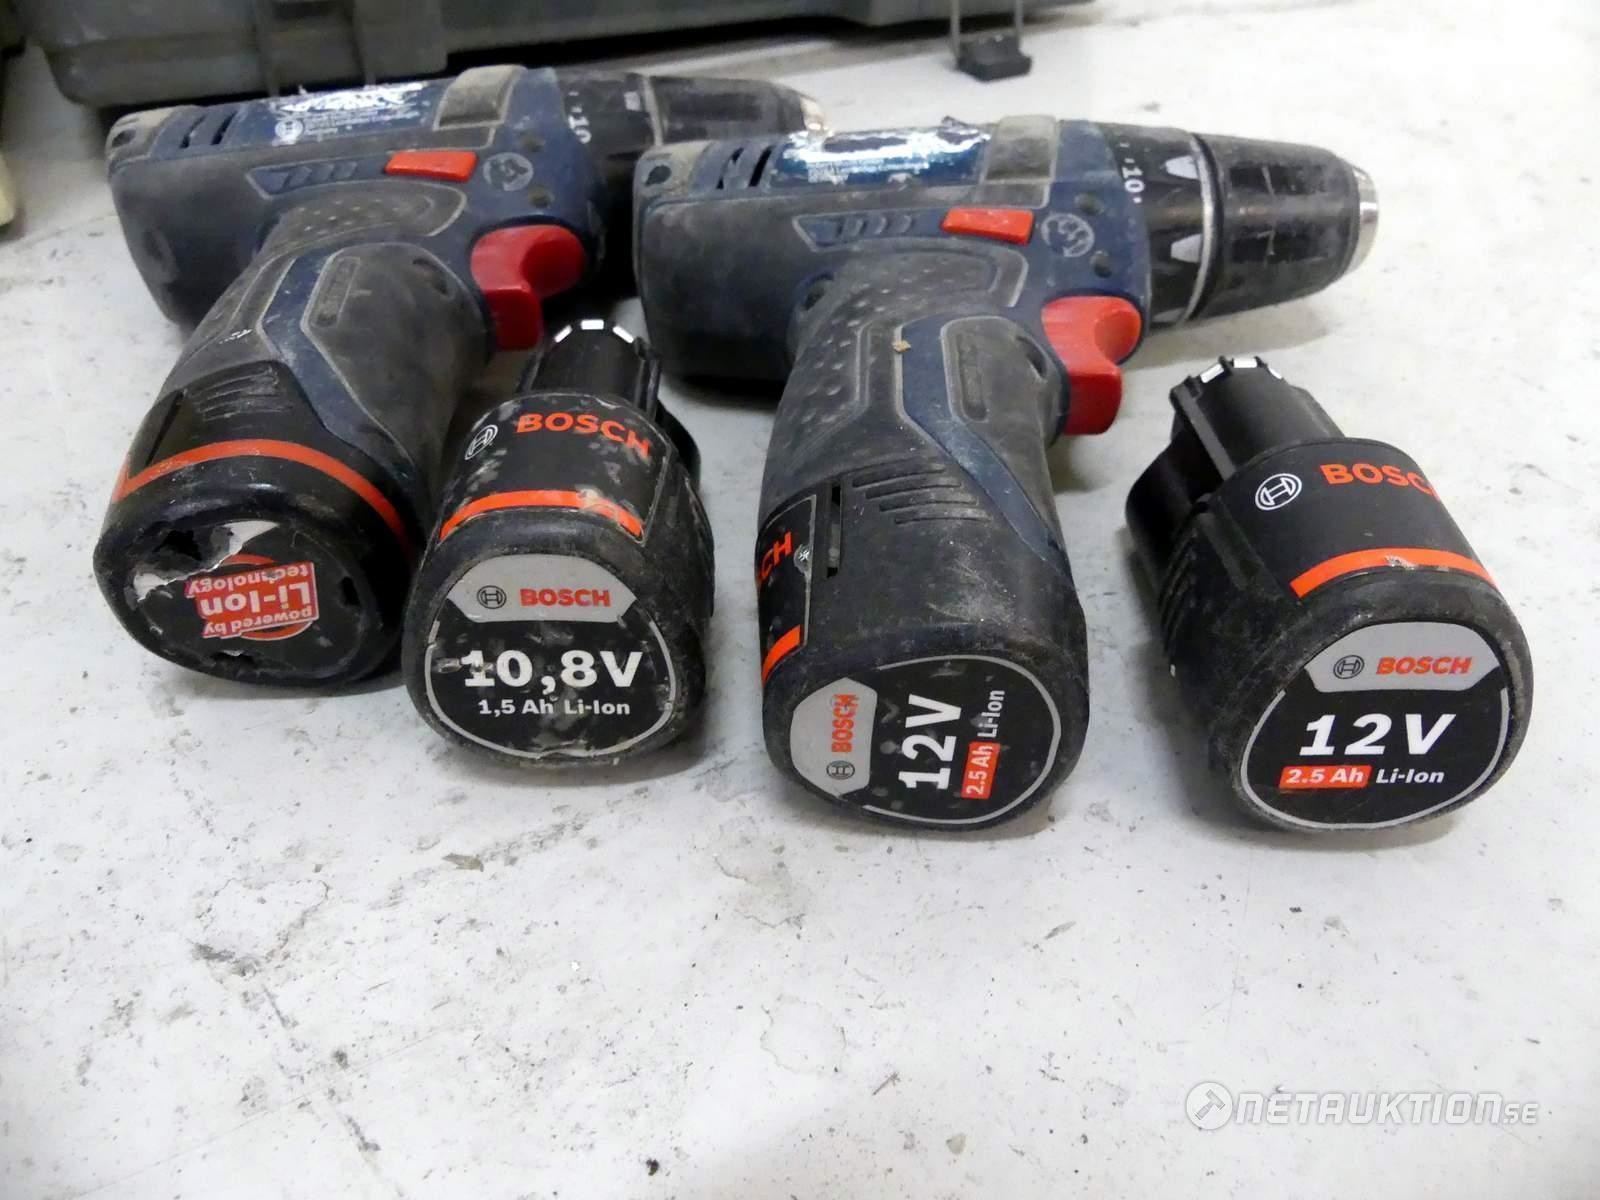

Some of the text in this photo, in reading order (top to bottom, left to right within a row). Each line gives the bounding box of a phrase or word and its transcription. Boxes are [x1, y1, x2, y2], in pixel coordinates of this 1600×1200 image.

[1121, 166, 1145, 193] 10
[515, 411, 651, 460] BOSCH
[1319, 462, 1439, 499] BOSC
[187, 564, 309, 597] technology
[200, 581, 311, 616] Li-Ion
[519, 588, 611, 607] BOSCH
[203, 605, 313, 637] powered by
[461, 650, 643, 695] 10,8V
[1375, 656, 1473, 675] BOSCH
[478, 699, 630, 717] 1,5 Ah Li-Ion
[831, 693, 859, 753] BOSCH
[966, 690, 1006, 795] 2.5 Ah Li-Ion
[1286, 768, 1444, 784] 2.5 Ah Li-Ion
